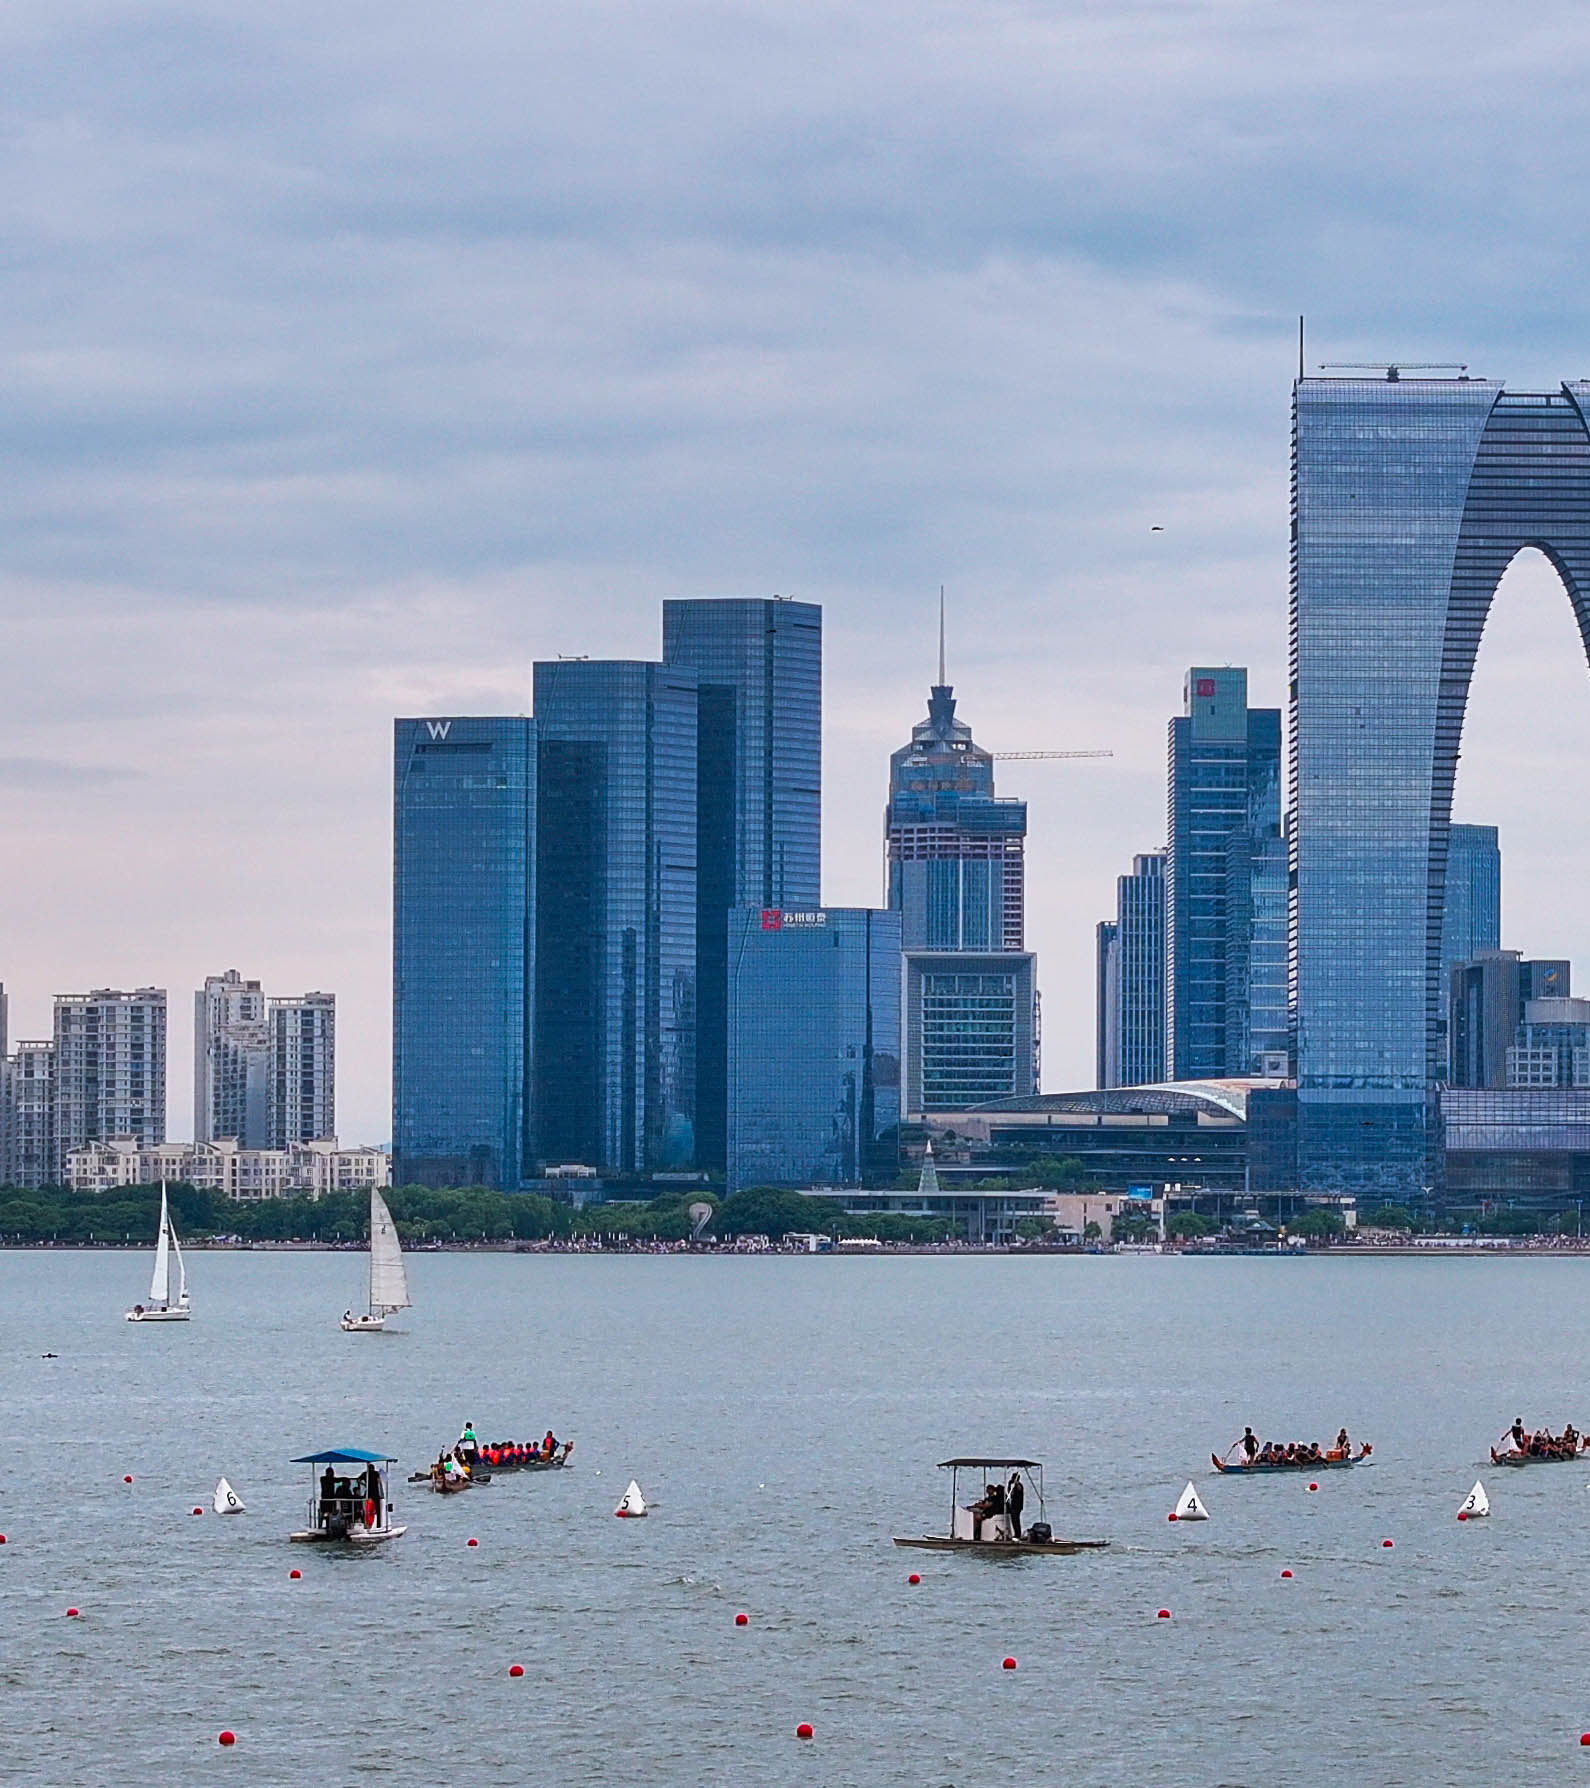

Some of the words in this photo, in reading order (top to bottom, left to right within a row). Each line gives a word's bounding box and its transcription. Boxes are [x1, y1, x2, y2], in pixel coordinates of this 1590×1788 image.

[426, 721, 452, 741] W
[226, 1491, 237, 1506] 6
[621, 1495, 631, 1510] 5
[1187, 1496, 1198, 1512] 4
[1466, 1495, 1476, 1510] 3
